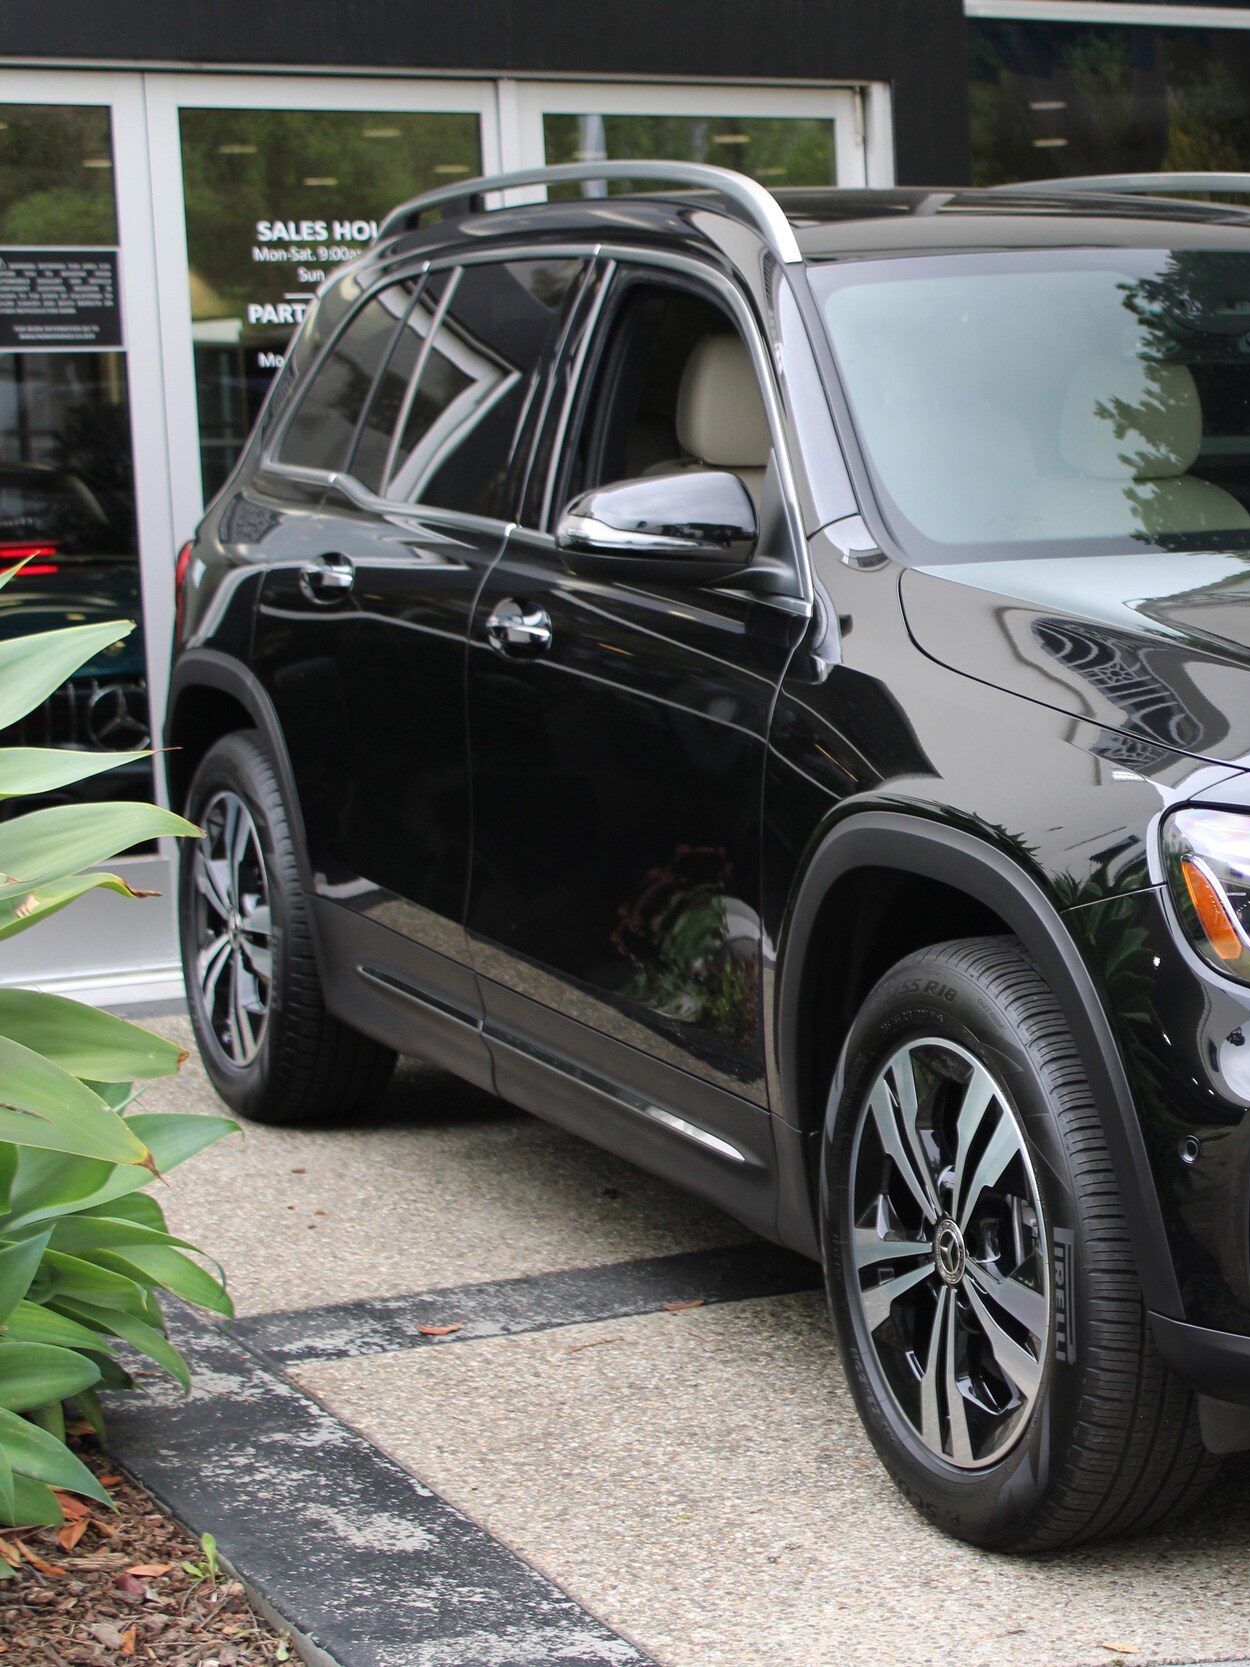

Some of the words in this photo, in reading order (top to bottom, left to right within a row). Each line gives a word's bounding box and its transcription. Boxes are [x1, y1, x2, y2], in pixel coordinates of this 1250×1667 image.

[256, 220, 329, 241] SALES
[252, 246, 316, 262] Mon-Sat.
[317, 245, 361, 261] 9:00a
[247, 303, 306, 324] PART
[258, 352, 285, 368] Mo
[1053, 1226, 1077, 1366] PIRELLI
